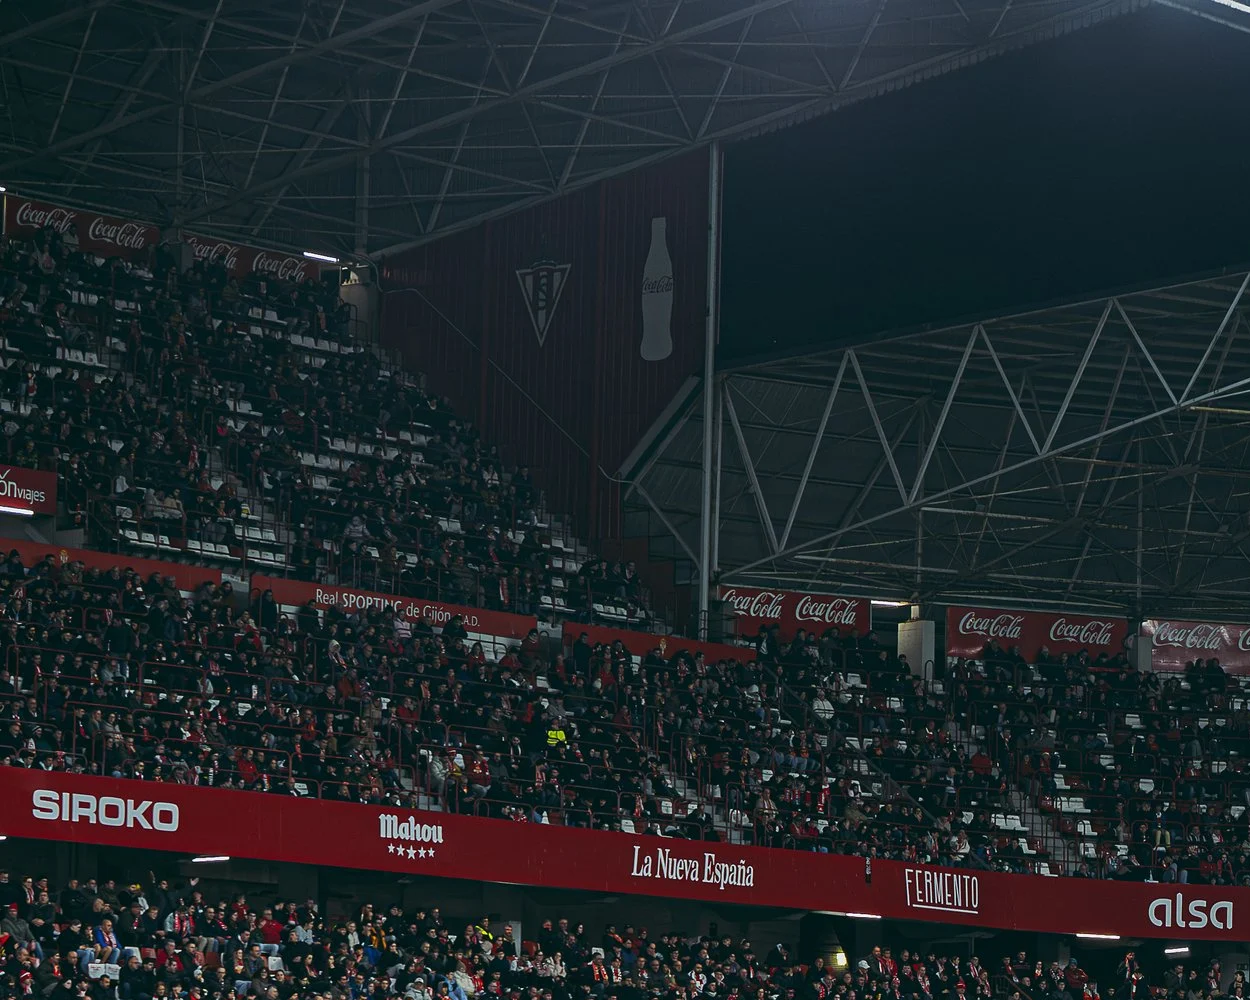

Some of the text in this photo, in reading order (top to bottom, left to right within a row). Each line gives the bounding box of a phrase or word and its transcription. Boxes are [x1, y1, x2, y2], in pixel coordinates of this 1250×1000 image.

[316, 588, 339, 605] Real
[406, 602, 420, 618] de
[795, 596, 859, 626] Coca-Cola
[959, 611, 1025, 640] Coca-Cola
[1050, 617, 1115, 646] Coca-Cola
[1152, 621, 1224, 650] Coca-Cola
[32, 789, 180, 832] SIROKO
[378, 813, 444, 844] Mahou
[631, 845, 754, 890] La Nueva España
[904, 868, 979, 908] FERMENTO
[1148, 892, 1233, 930] alsa
